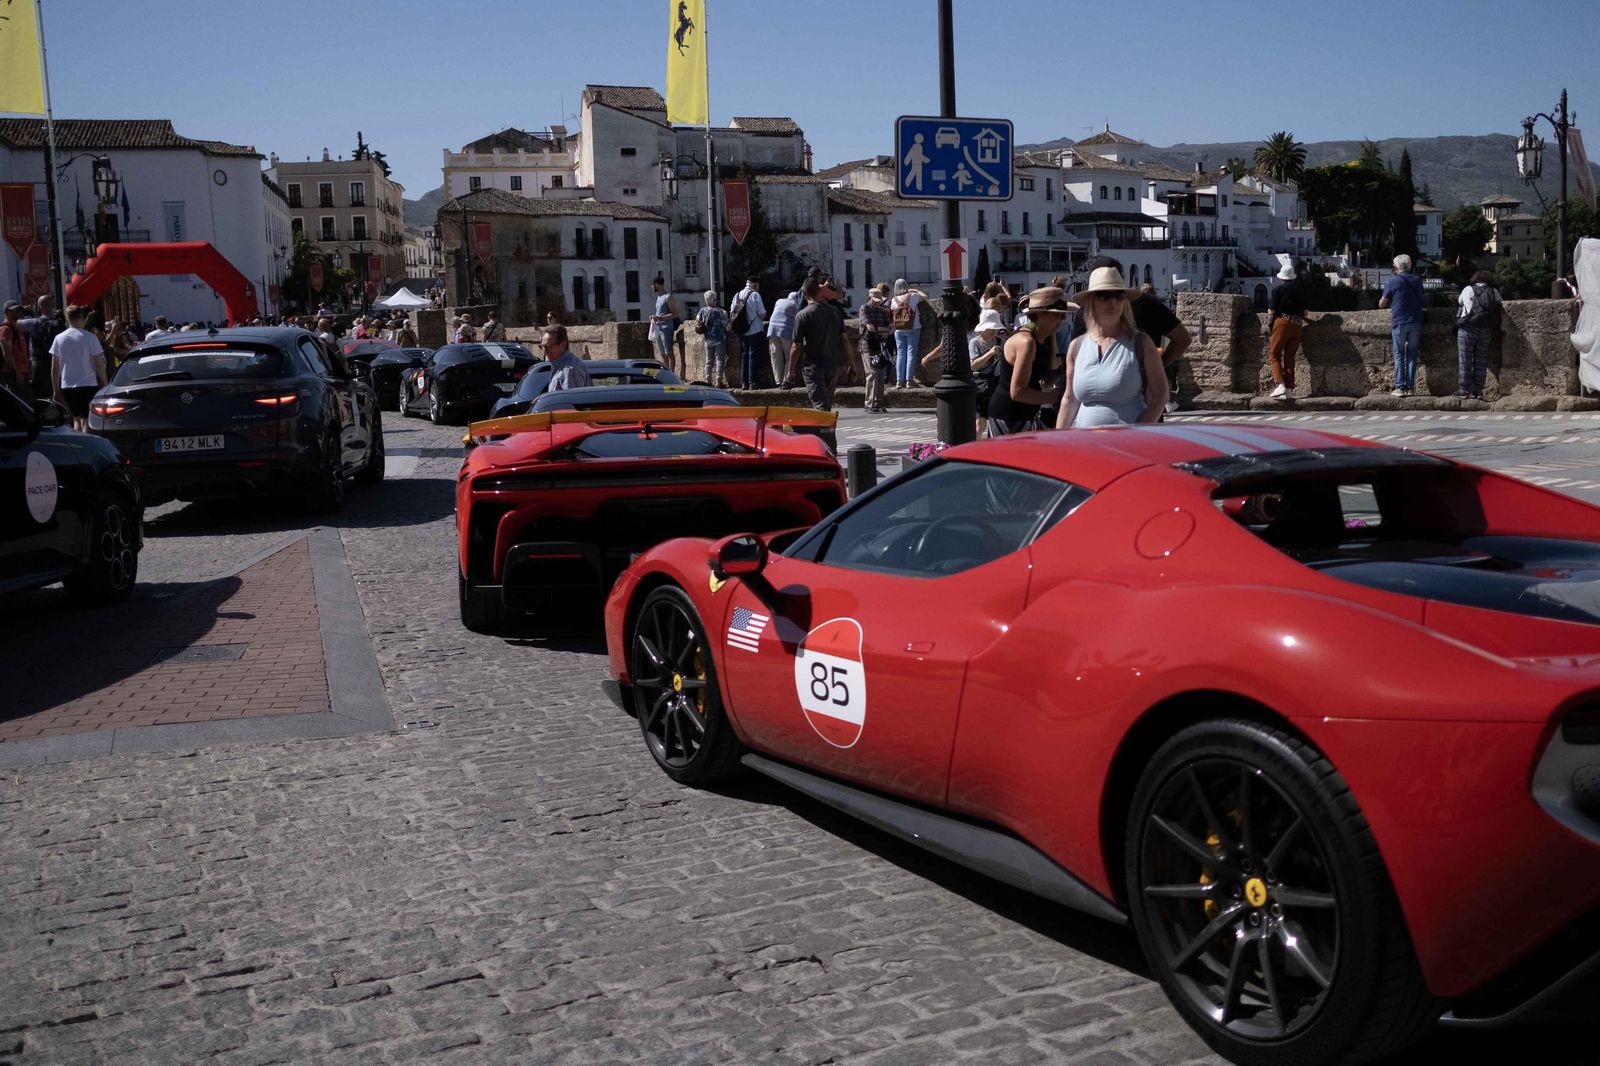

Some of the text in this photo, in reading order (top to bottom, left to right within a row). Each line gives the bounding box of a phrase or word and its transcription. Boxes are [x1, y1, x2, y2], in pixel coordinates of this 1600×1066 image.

[163, 435, 222, 450] 9412 MLK
[28, 483, 57, 496] PACE CAR
[811, 661, 849, 706] 85
